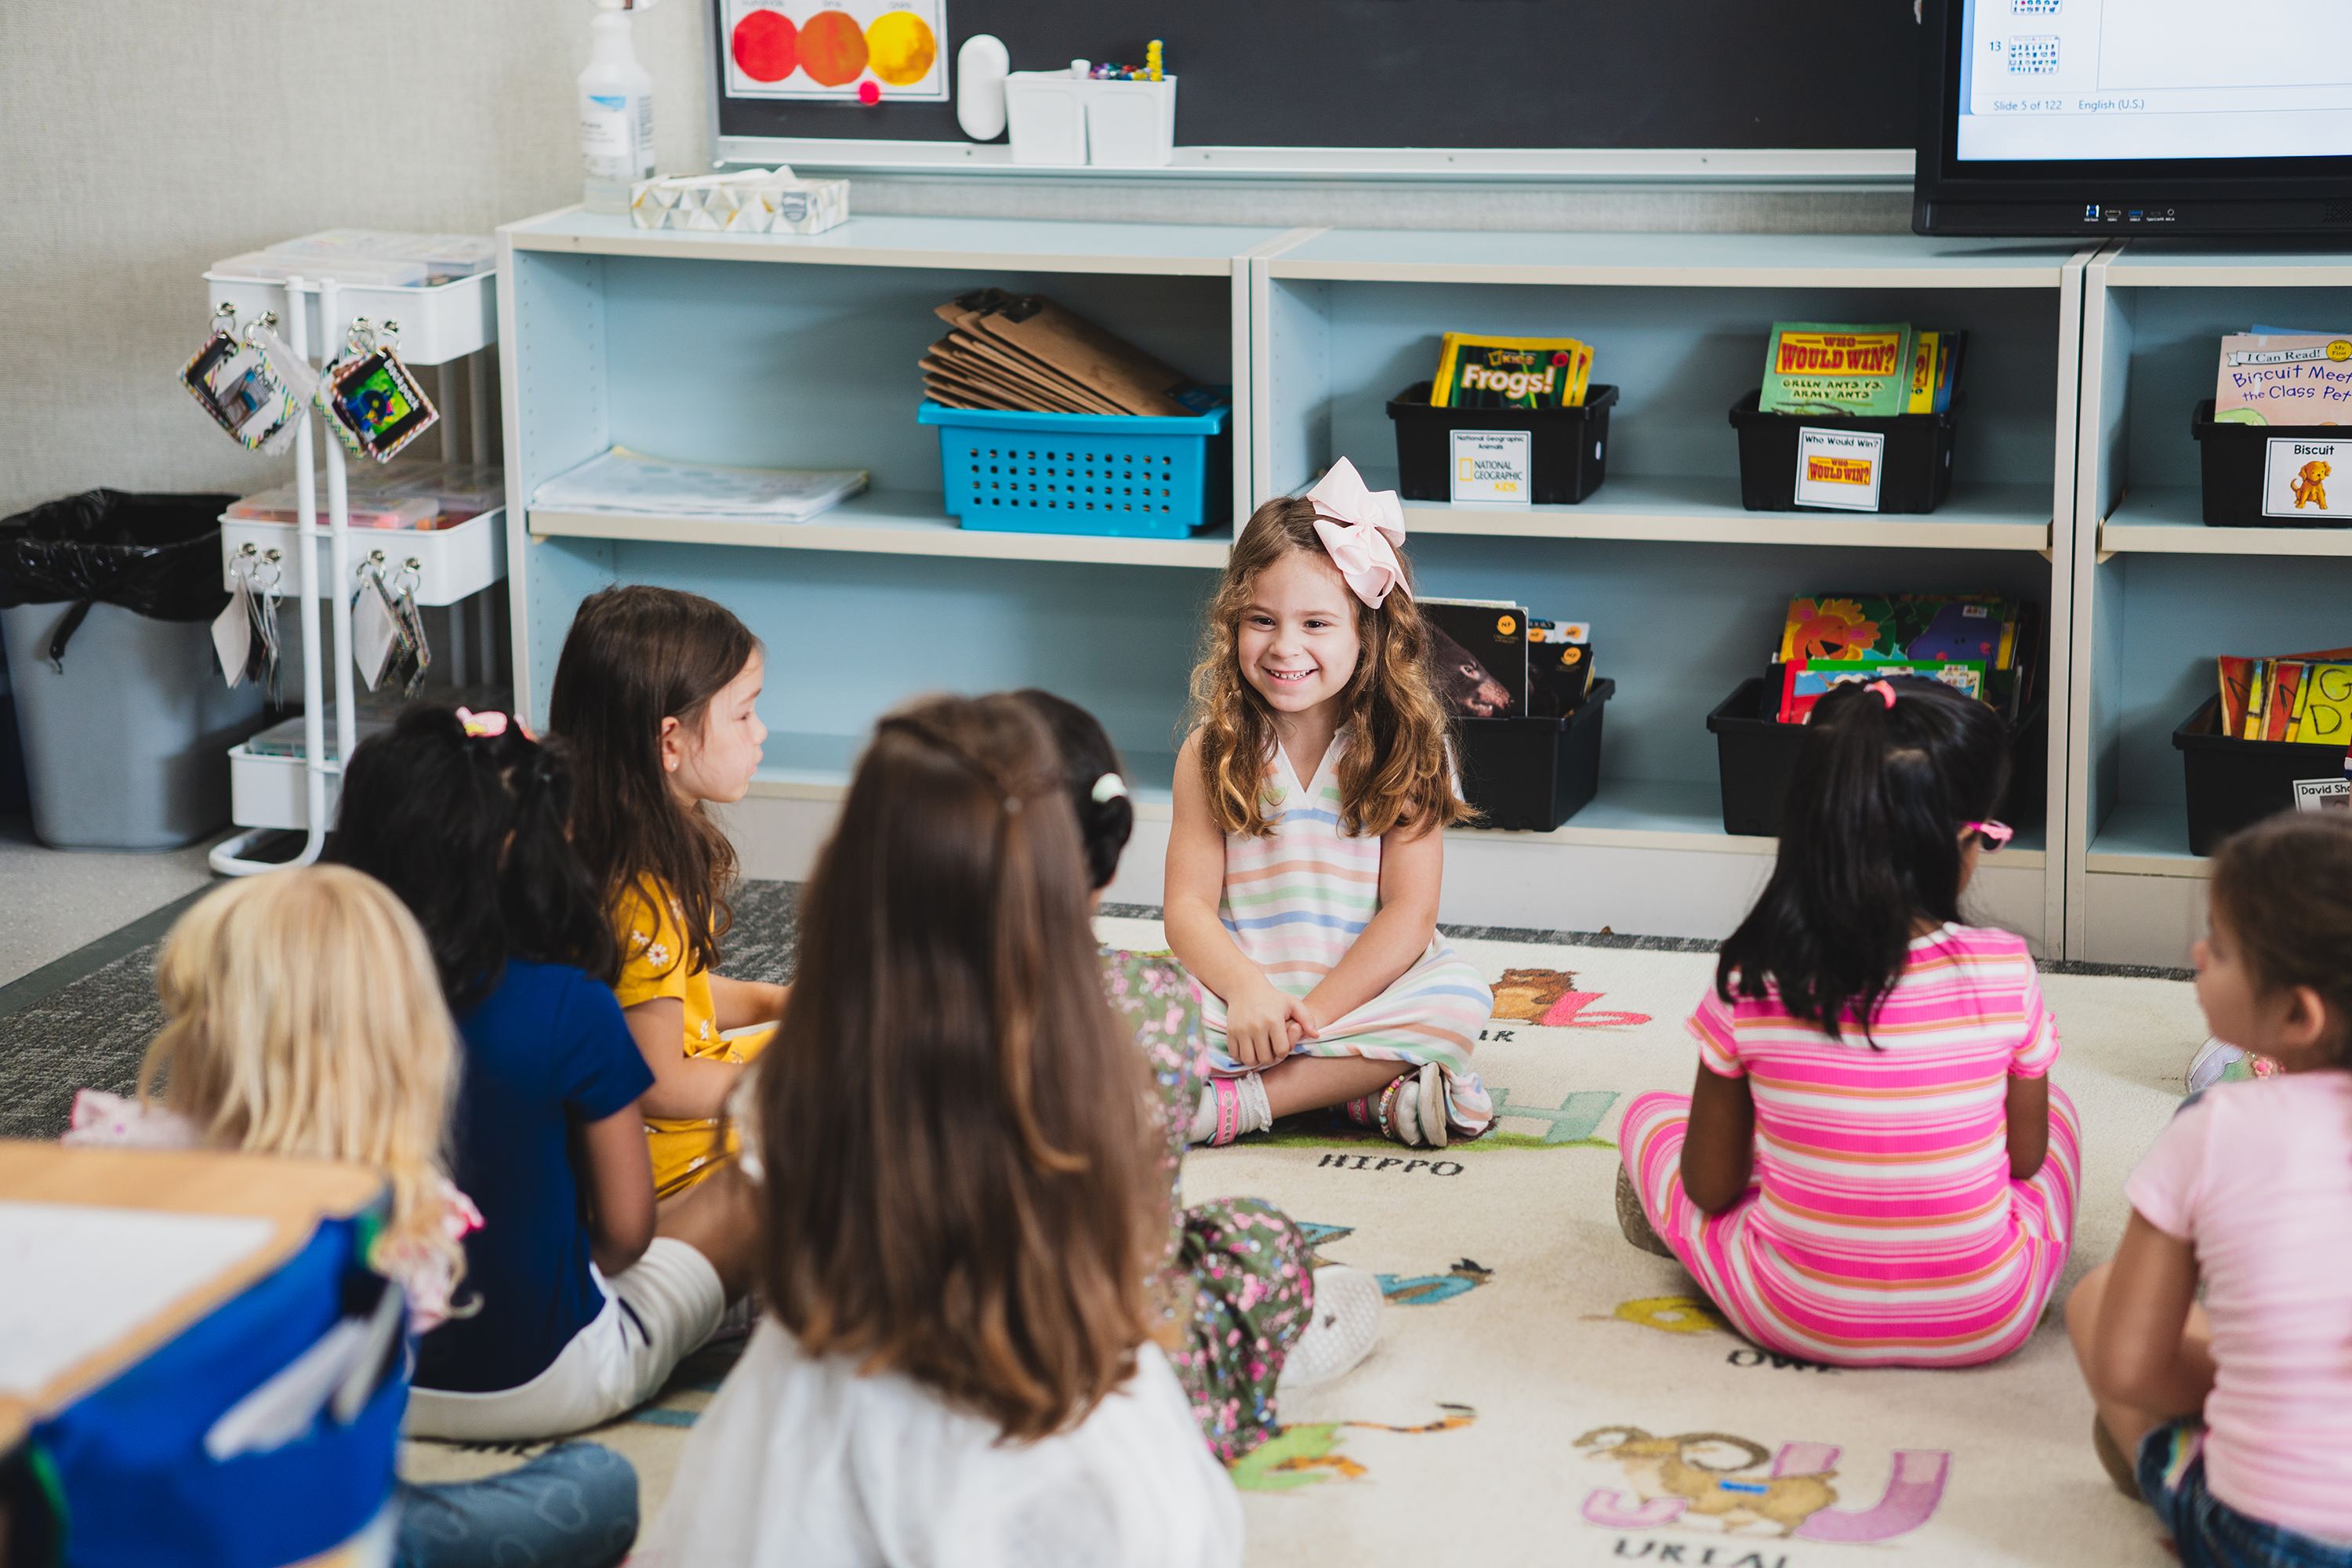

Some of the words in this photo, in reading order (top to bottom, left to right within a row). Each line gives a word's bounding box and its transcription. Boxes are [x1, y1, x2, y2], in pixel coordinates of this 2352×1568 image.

[1990, 41, 2002, 51] 13
[1994, 100, 2018, 111] Slide
[2021, 100, 2027, 111] 5
[2030, 100, 2041, 111] of
[2045, 100, 2062, 111] 122
[2078, 100, 2114, 112] English
[2118, 99, 2144, 111] (U.S.)
[1824, 336, 1856, 347] WHO
[1781, 343, 1845, 371] WOULD
[1847, 343, 1895, 372] WIN?
[2256, 354, 2281, 362] Can
[2285, 350, 2321, 360] Read!
[1461, 363, 1557, 399] Frogs!
[2233, 365, 2303, 388] Biscuit
[383, 358, 420, 412] Backpack
[1783, 379, 1822, 388] GREEN
[1827, 379, 1860, 389] ANTS
[1792, 390, 1830, 398] ARMY
[2242, 391, 2265, 401] the
[2269, 385, 2315, 398] Class
[2323, 386, 2352, 402] Pet
[1805, 434, 1824, 444] Who
[1828, 437, 1854, 446] Would
[1857, 439, 1878, 448] Win?
[2294, 445, 2335, 456] Biscuit
[1475, 460, 1512, 470] NATIONAL
[1474, 470, 1523, 481] GEOGRAPHIC
[1809, 463, 1842, 480] WOULD
[1844, 466, 1869, 484] WIN?
[1494, 481, 1517, 492] KIDS
[2301, 785, 2332, 795] David
[1317, 1153, 1465, 1176] HIPPO
